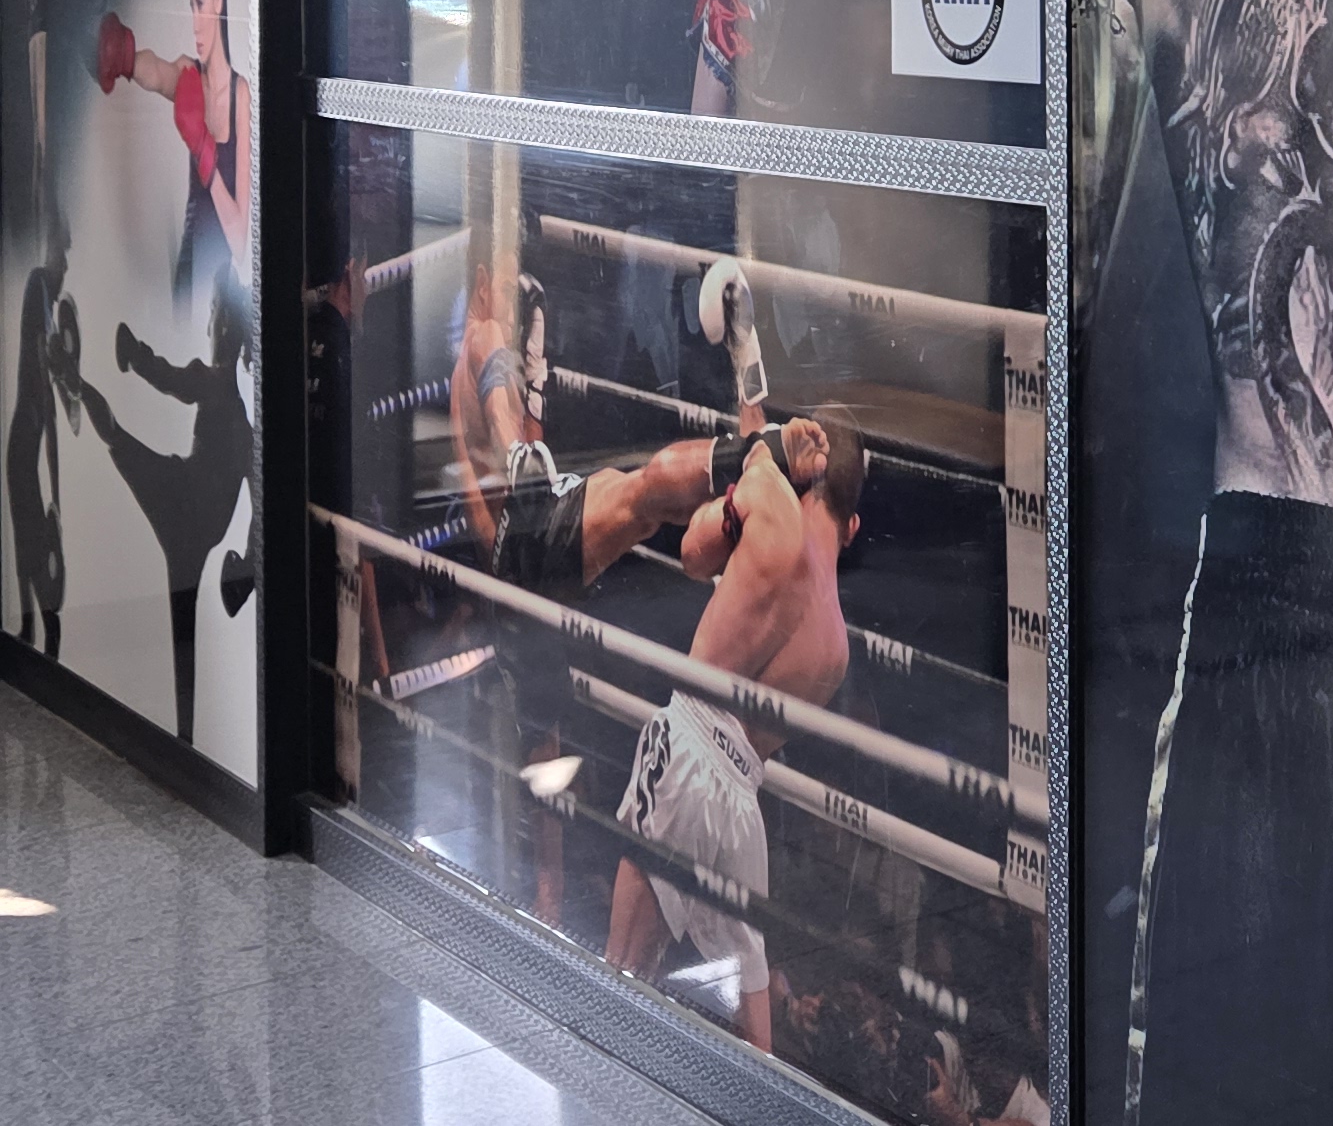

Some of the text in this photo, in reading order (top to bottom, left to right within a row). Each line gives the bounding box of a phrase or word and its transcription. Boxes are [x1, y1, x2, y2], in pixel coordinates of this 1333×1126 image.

[970, 4, 1002, 59] ASSOCIATION
[1006, 369, 1045, 396] THAI
[1006, 487, 1045, 516] THAI
[1009, 606, 1047, 637] THAI
[713, 726, 751, 777] ISUZU
[1009, 723, 1047, 757] THAI
[1007, 840, 1046, 875] THAI
